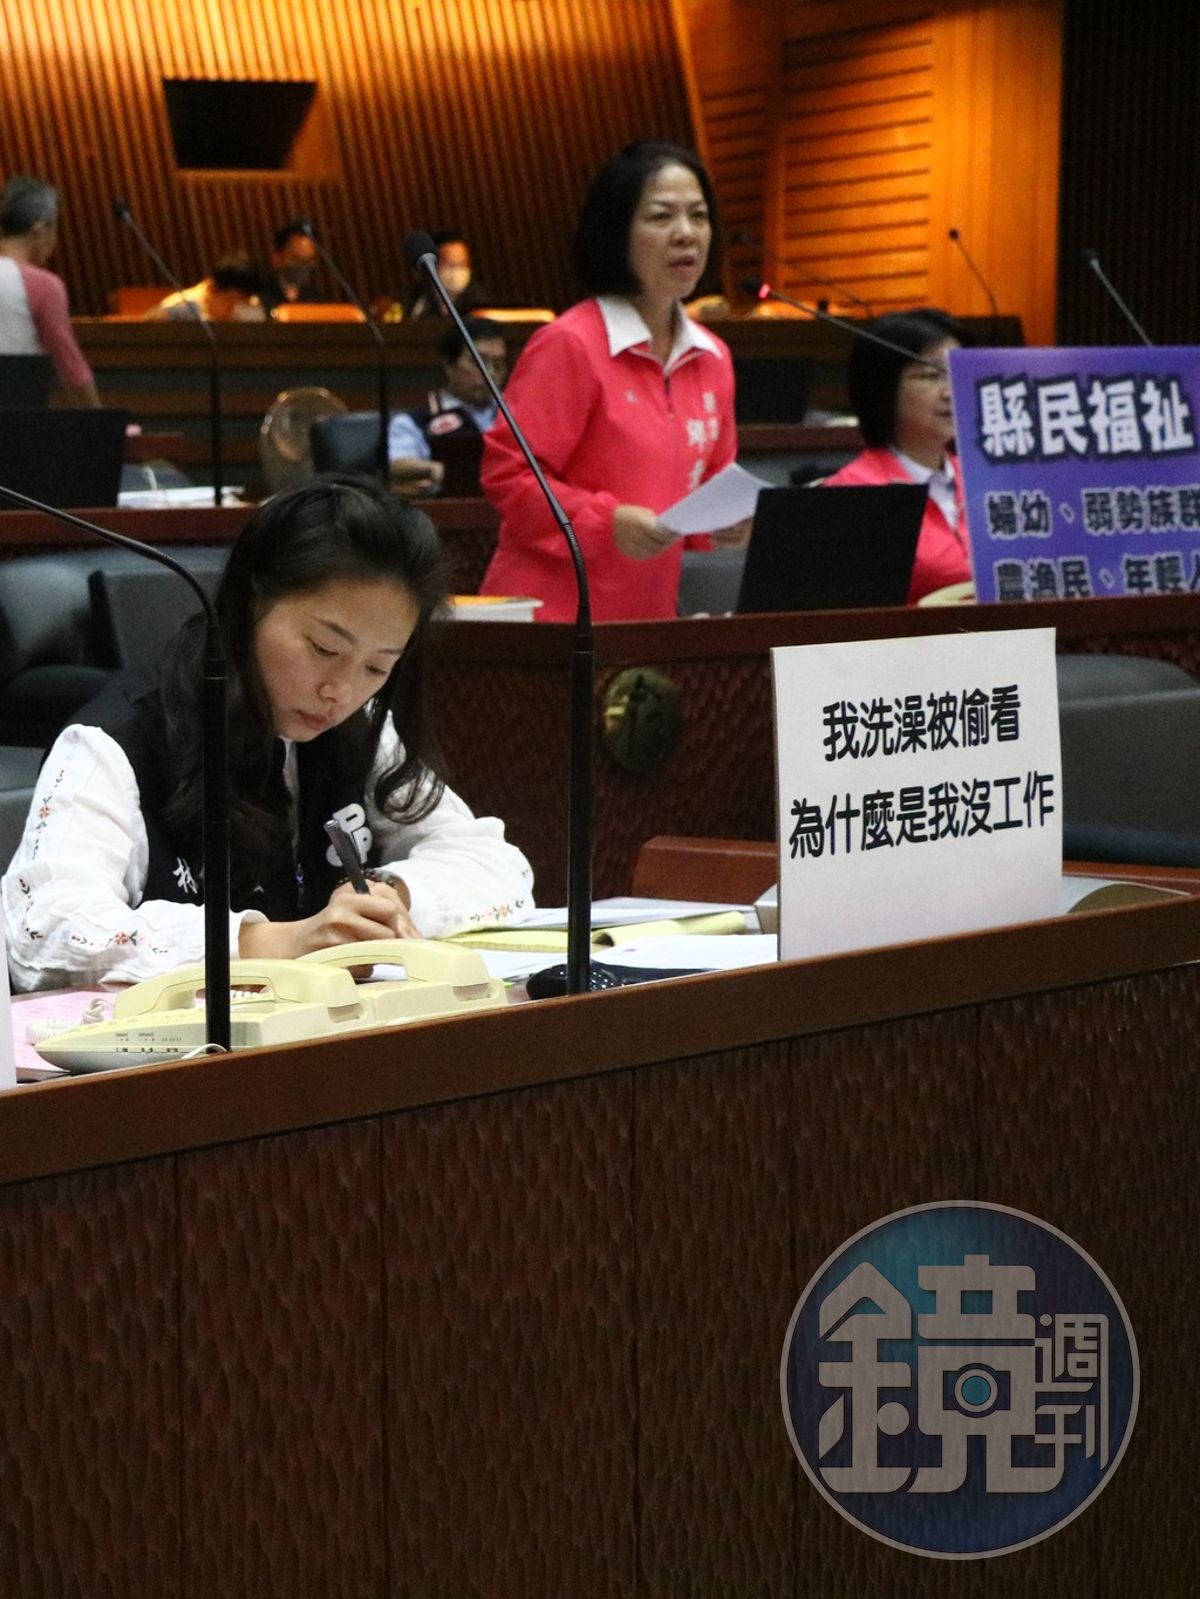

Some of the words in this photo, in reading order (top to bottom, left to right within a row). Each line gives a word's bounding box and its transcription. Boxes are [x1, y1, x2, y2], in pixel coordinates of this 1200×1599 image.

[978, 377, 1196, 460] 縣民福祉
[822, 684, 1021, 762] 我洗澡被偷看
[788, 770, 1055, 860] 為什麼是我沒工作
